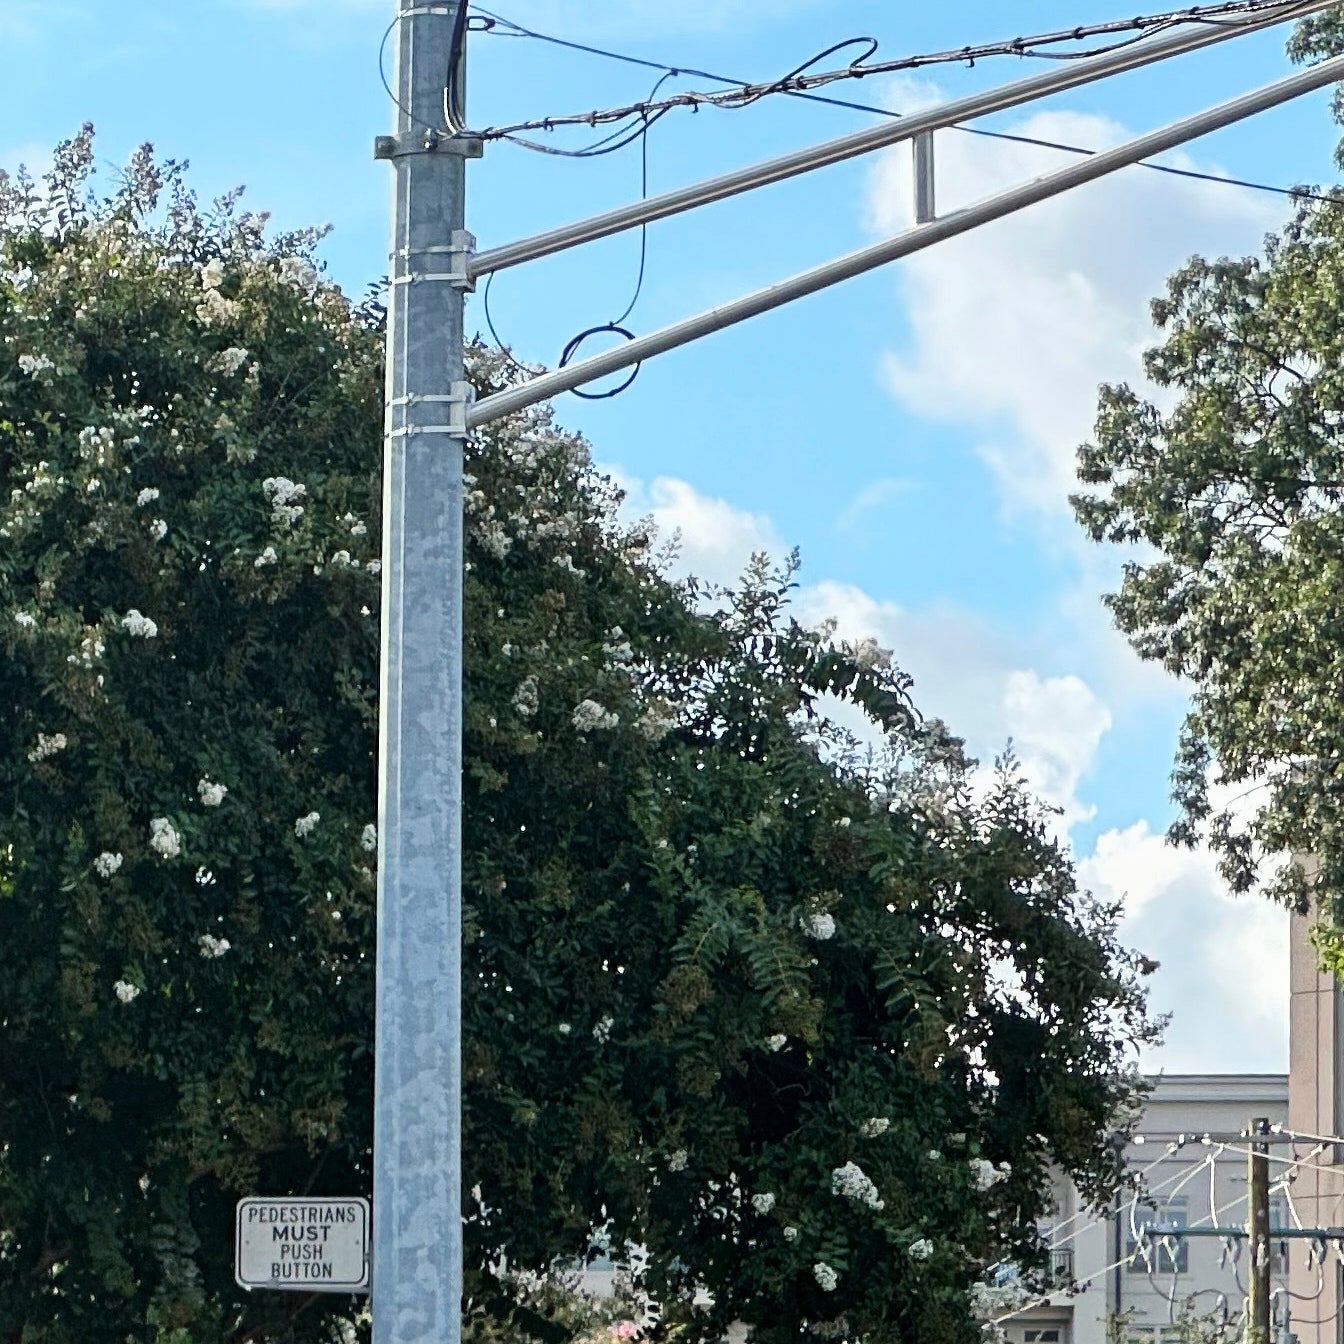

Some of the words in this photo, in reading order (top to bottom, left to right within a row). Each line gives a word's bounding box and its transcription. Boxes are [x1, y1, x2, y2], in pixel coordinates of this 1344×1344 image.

[248, 1206, 356, 1223] PEDESTRIANS
[272, 1226, 332, 1242] MUST
[280, 1245, 324, 1260] PUSH
[271, 1263, 333, 1279] BUTTON
